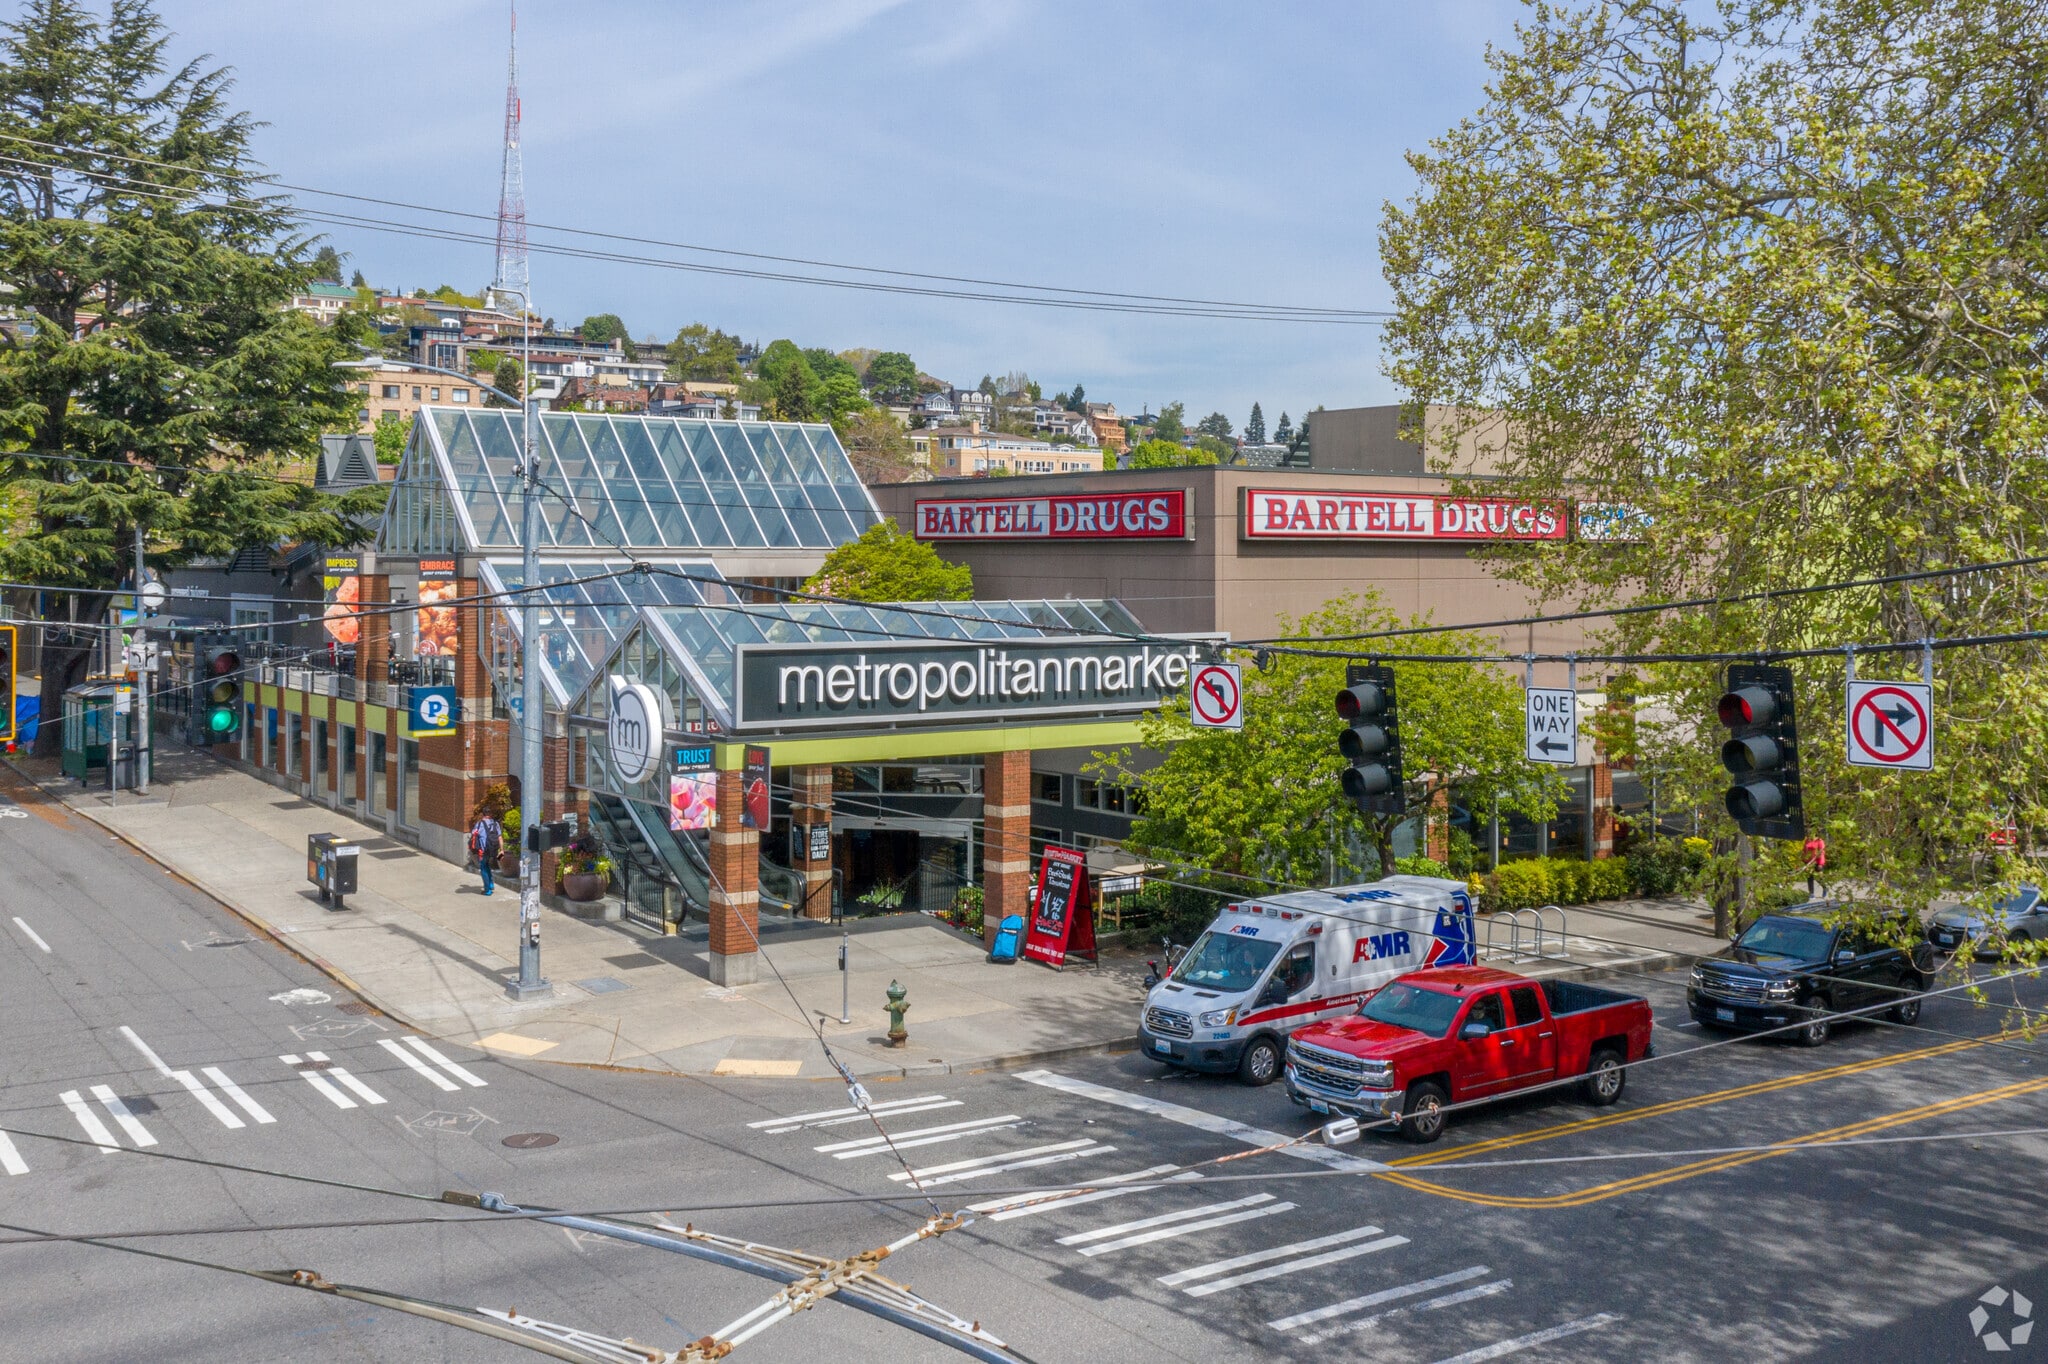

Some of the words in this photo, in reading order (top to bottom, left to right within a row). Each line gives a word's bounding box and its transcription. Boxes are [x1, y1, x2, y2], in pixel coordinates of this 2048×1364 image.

[923, 504, 1041, 533] BARTELL
[1054, 498, 1170, 532] DRUGS
[1264, 497, 1426, 532] BARTELL
[1440, 502, 1557, 535] DRUGS
[326, 558, 358, 568] IMPRESS
[420, 560, 456, 571] EMBRACE
[428, 701, 442, 718] P
[1533, 694, 1569, 713] ONE
[1532, 715, 1570, 734] WAY
[676, 748, 712, 765] TRUST
[748, 750, 765, 765] LOVE
[810, 838, 829, 846] HOURS
[811, 830, 829, 839] STORE
[811, 850, 828, 860] DAILY
[1229, 924, 1260, 936] AMR
[1352, 931, 1411, 963] AMR
